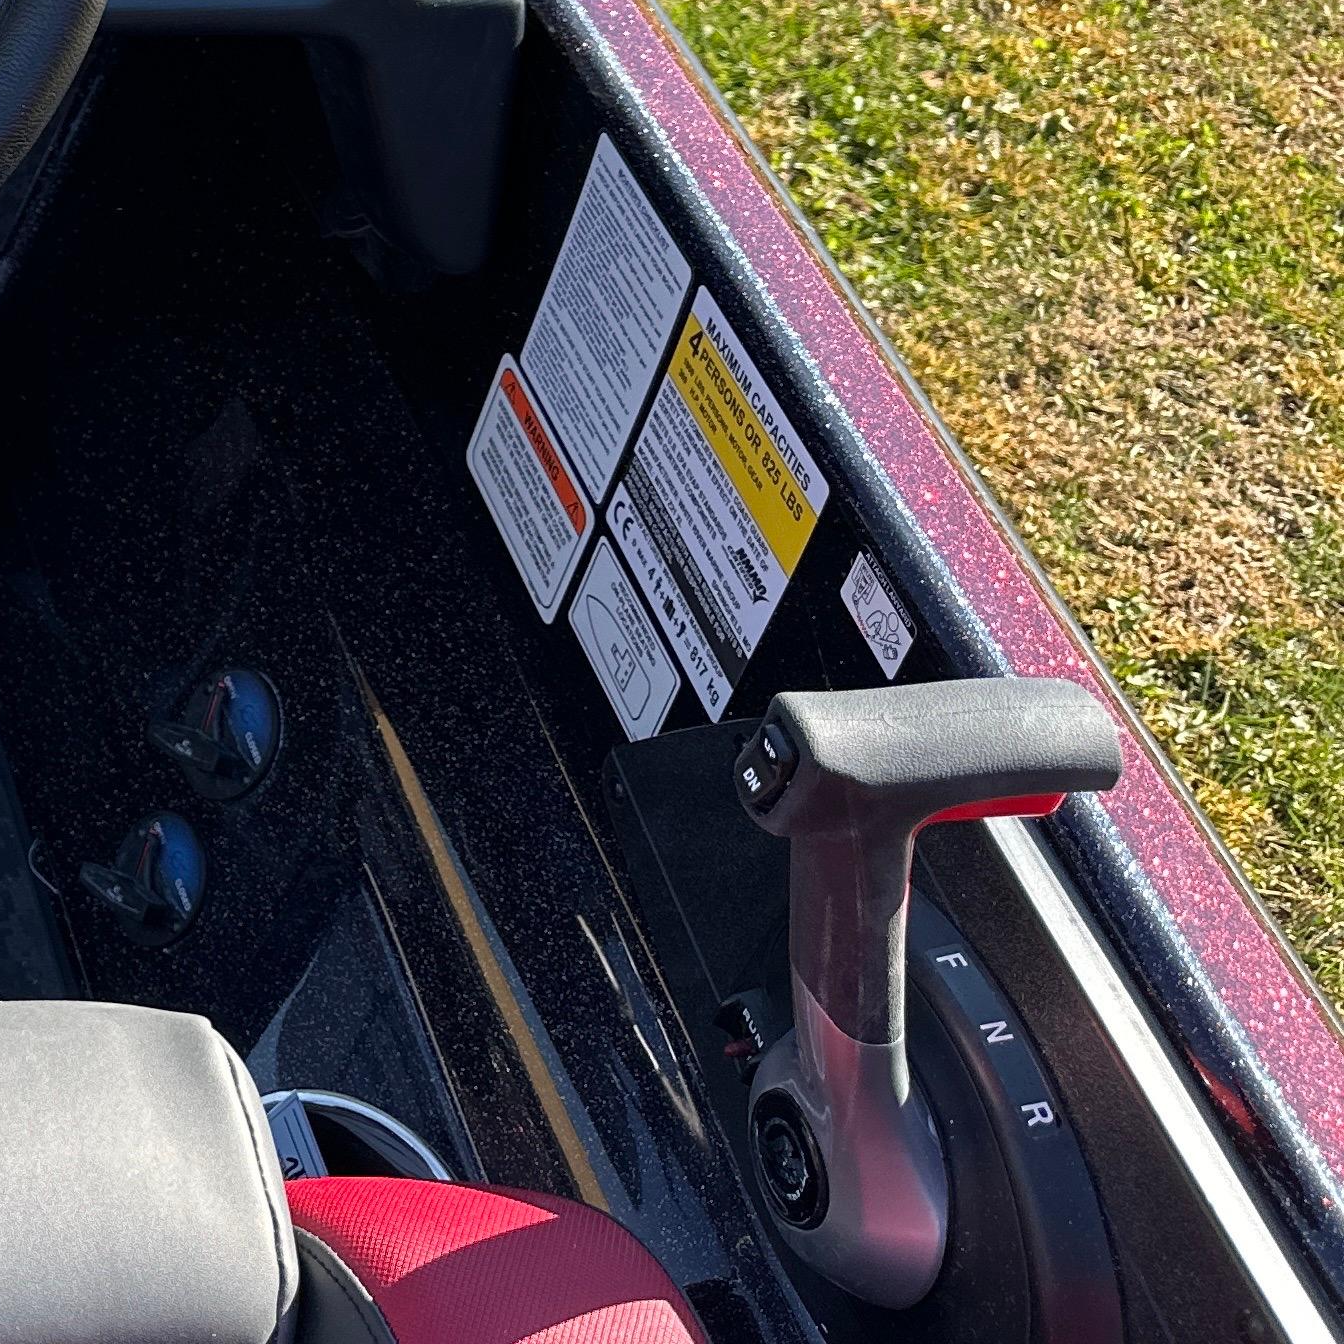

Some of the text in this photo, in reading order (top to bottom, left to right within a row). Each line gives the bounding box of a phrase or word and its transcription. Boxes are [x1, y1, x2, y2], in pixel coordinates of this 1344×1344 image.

[705, 317, 810, 491] MAXIMUM CAPACITIES
[688, 330, 803, 521] 4 PERSONS OR 825 LBS
[523, 410, 559, 481] WARNING
[746, 464, 763, 491] GEAR
[865, 552, 887, 591] ATTACH
[613, 500, 634, 541] CE
[689, 645, 708, 676] 817
[706, 677, 719, 707] kg
[763, 737, 776, 759] UP
[742, 767, 761, 792] DN
[935, 952, 968, 968] F
[742, 1007, 765, 1049] RUN
[980, 1020, 1014, 1043] N
[1020, 1101, 1054, 1127] R
